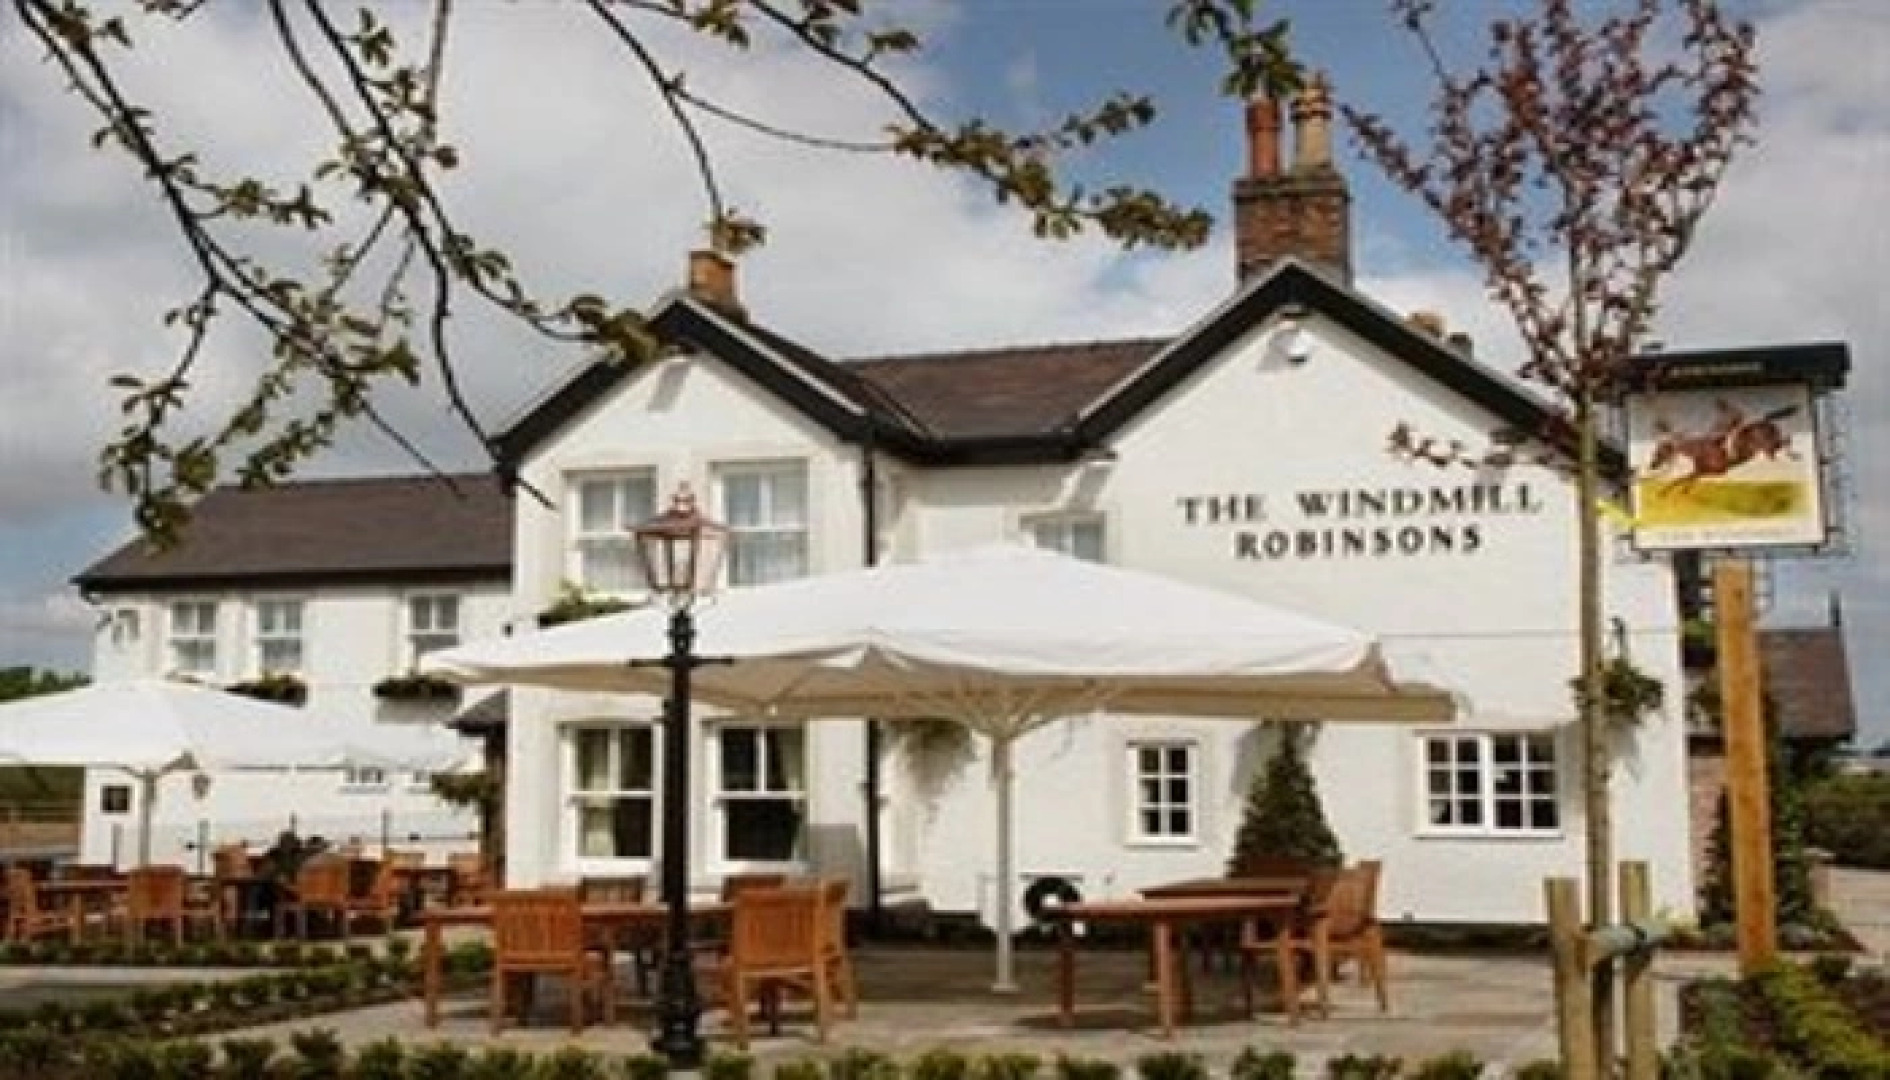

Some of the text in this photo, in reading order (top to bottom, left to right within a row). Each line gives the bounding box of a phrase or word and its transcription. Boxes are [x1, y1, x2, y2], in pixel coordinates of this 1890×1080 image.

[1177, 483, 1542, 523] THE WINDMILL
[1235, 525, 1481, 559] ROBINSONS
